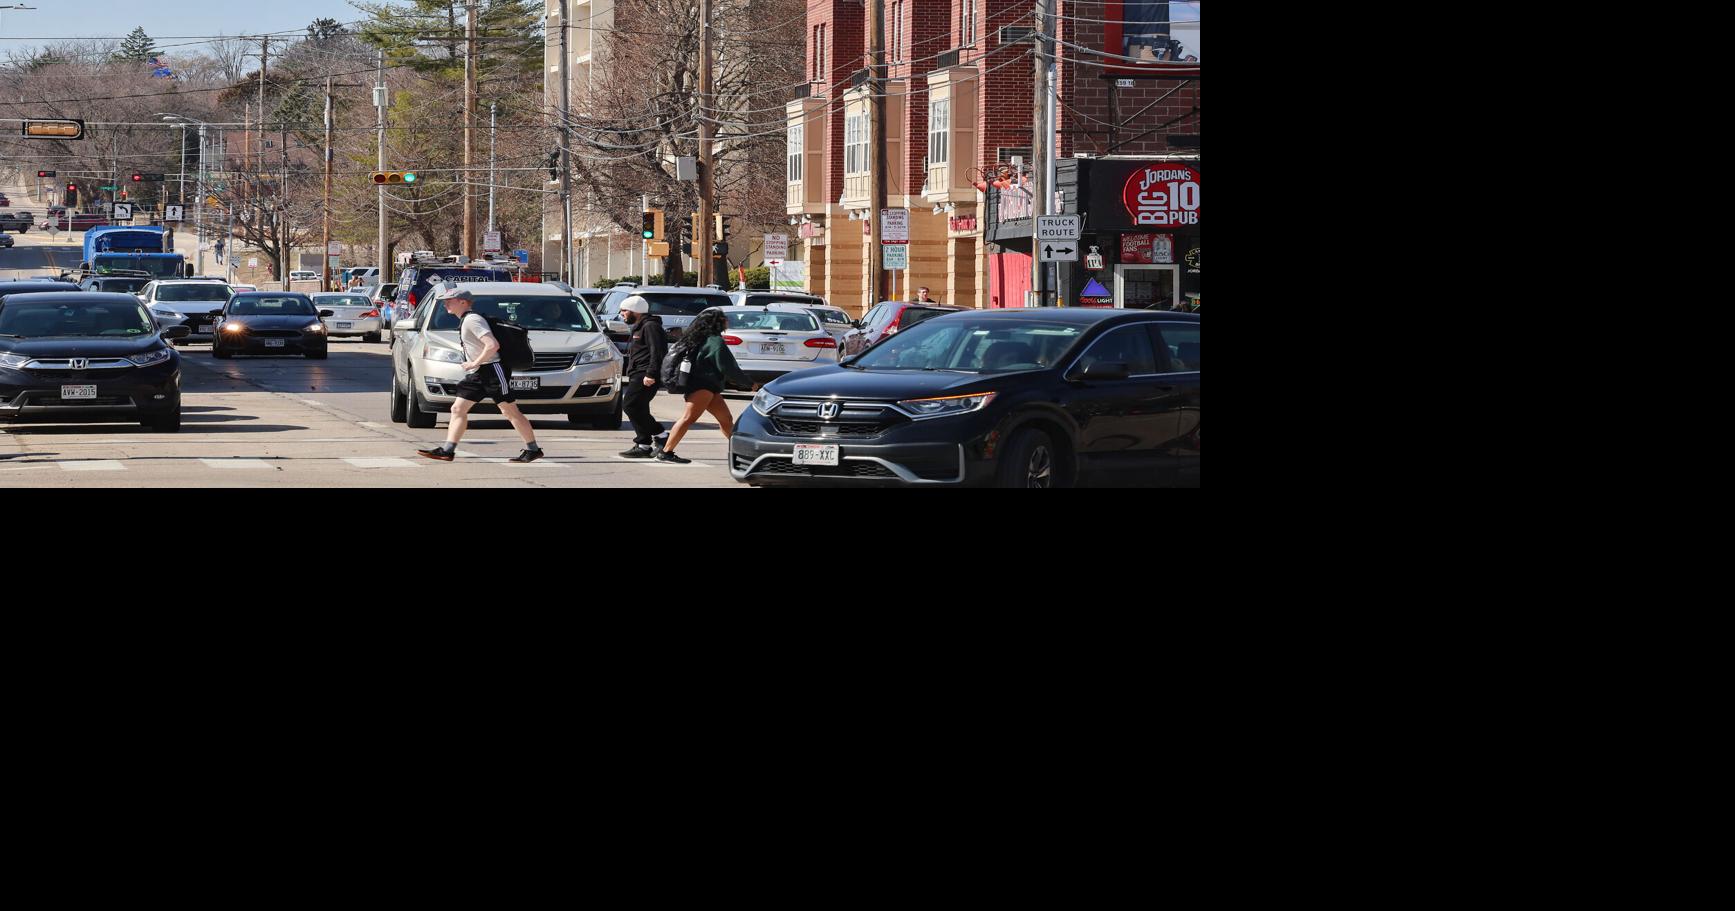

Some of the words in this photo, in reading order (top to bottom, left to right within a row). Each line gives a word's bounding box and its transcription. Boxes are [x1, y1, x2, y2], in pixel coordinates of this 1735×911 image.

[1140, 168, 1191, 190] JORDAN'S
[1167, 182, 1200, 211] 10
[1138, 192, 1168, 225] BIG
[1041, 219, 1075, 227] TRUCK
[1169, 211, 1198, 225] PUB
[1122, 239, 1150, 248] FOOTBALL
